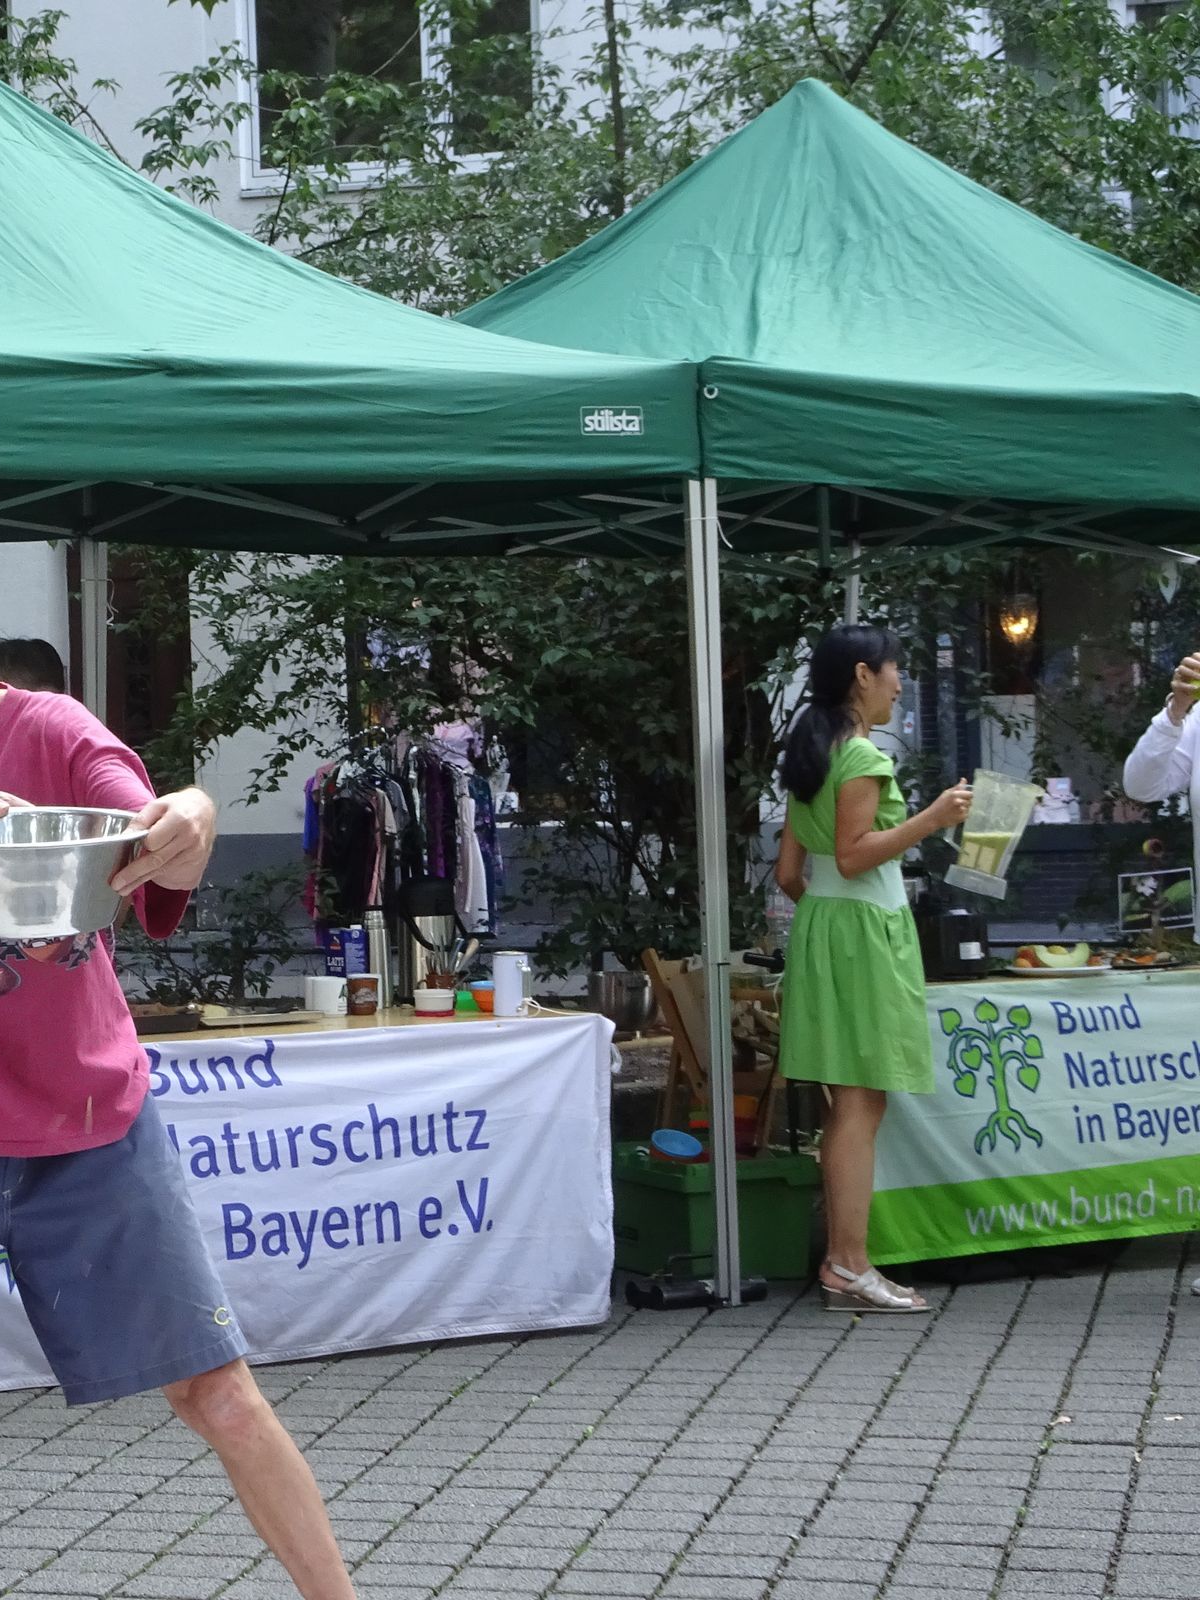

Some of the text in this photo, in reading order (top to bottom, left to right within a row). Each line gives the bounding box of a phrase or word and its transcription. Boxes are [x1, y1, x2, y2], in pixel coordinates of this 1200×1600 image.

[584, 409, 640, 431] stilista
[1049, 993, 1141, 1035] Bund
[145, 1039, 282, 1097] Bund
[1073, 1105, 1106, 1144] in
[221, 1176, 494, 1270] Bayern e.V.
[966, 1177, 1200, 1236] www.bund-n
